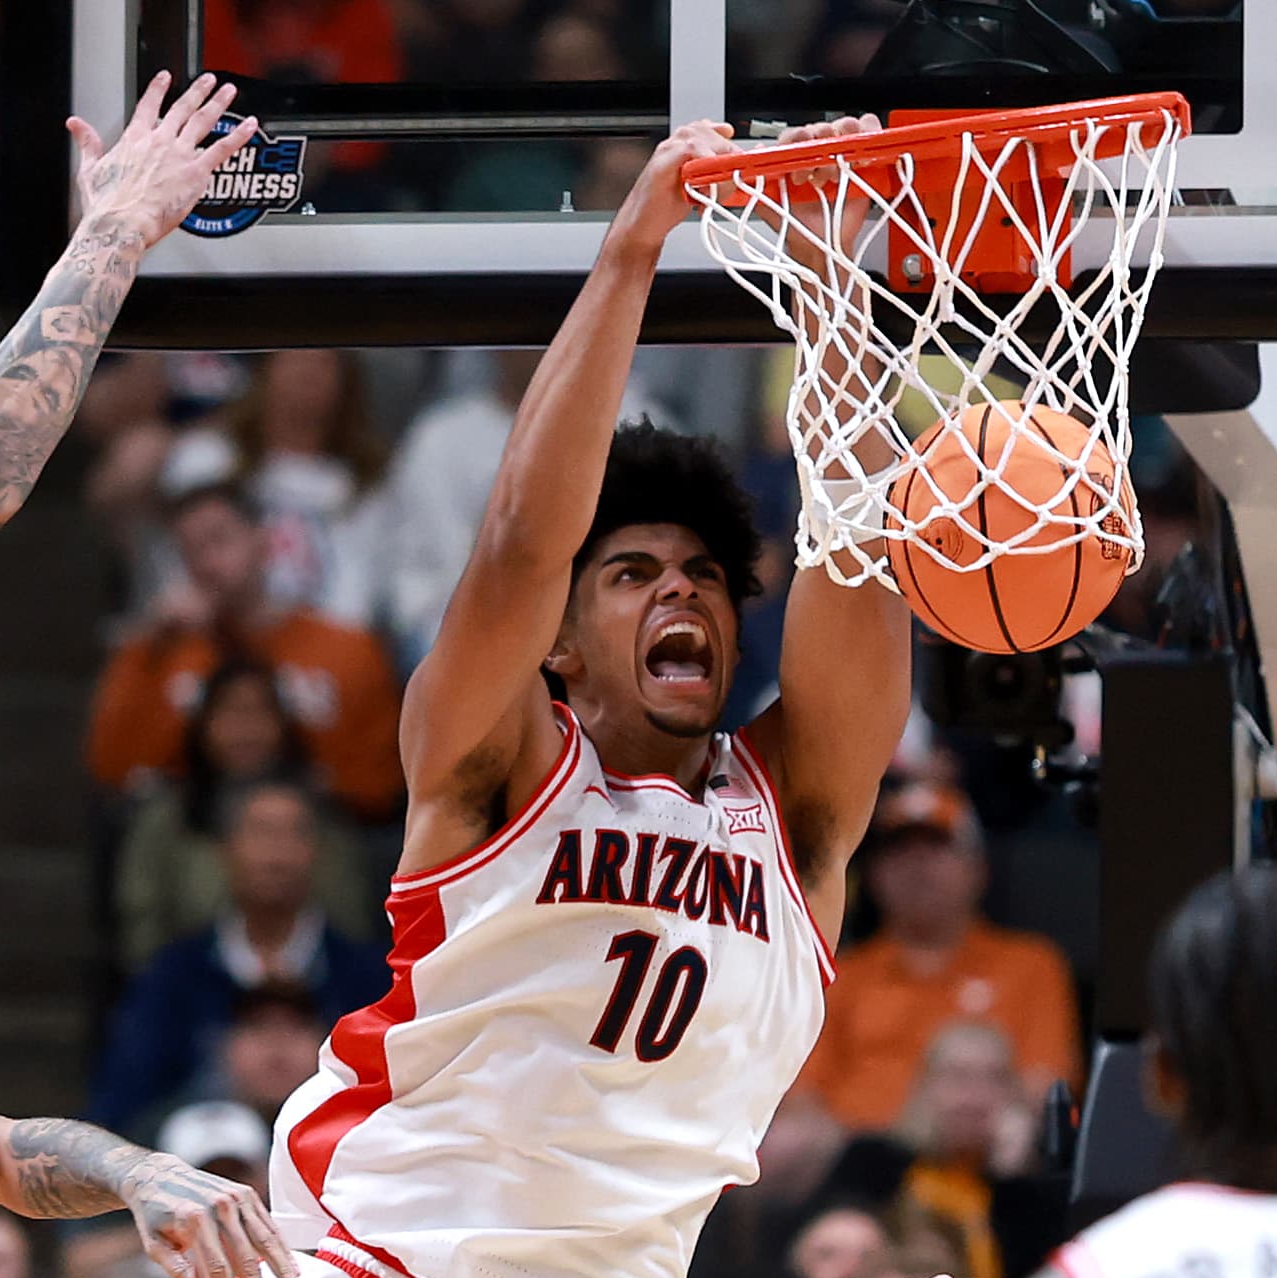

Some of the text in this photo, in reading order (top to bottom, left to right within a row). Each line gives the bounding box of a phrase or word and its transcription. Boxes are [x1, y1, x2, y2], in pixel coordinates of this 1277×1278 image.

[202, 173, 299, 199] ADNESS
[535, 828, 770, 944] ARIZONA
[588, 929, 709, 1063] 10
